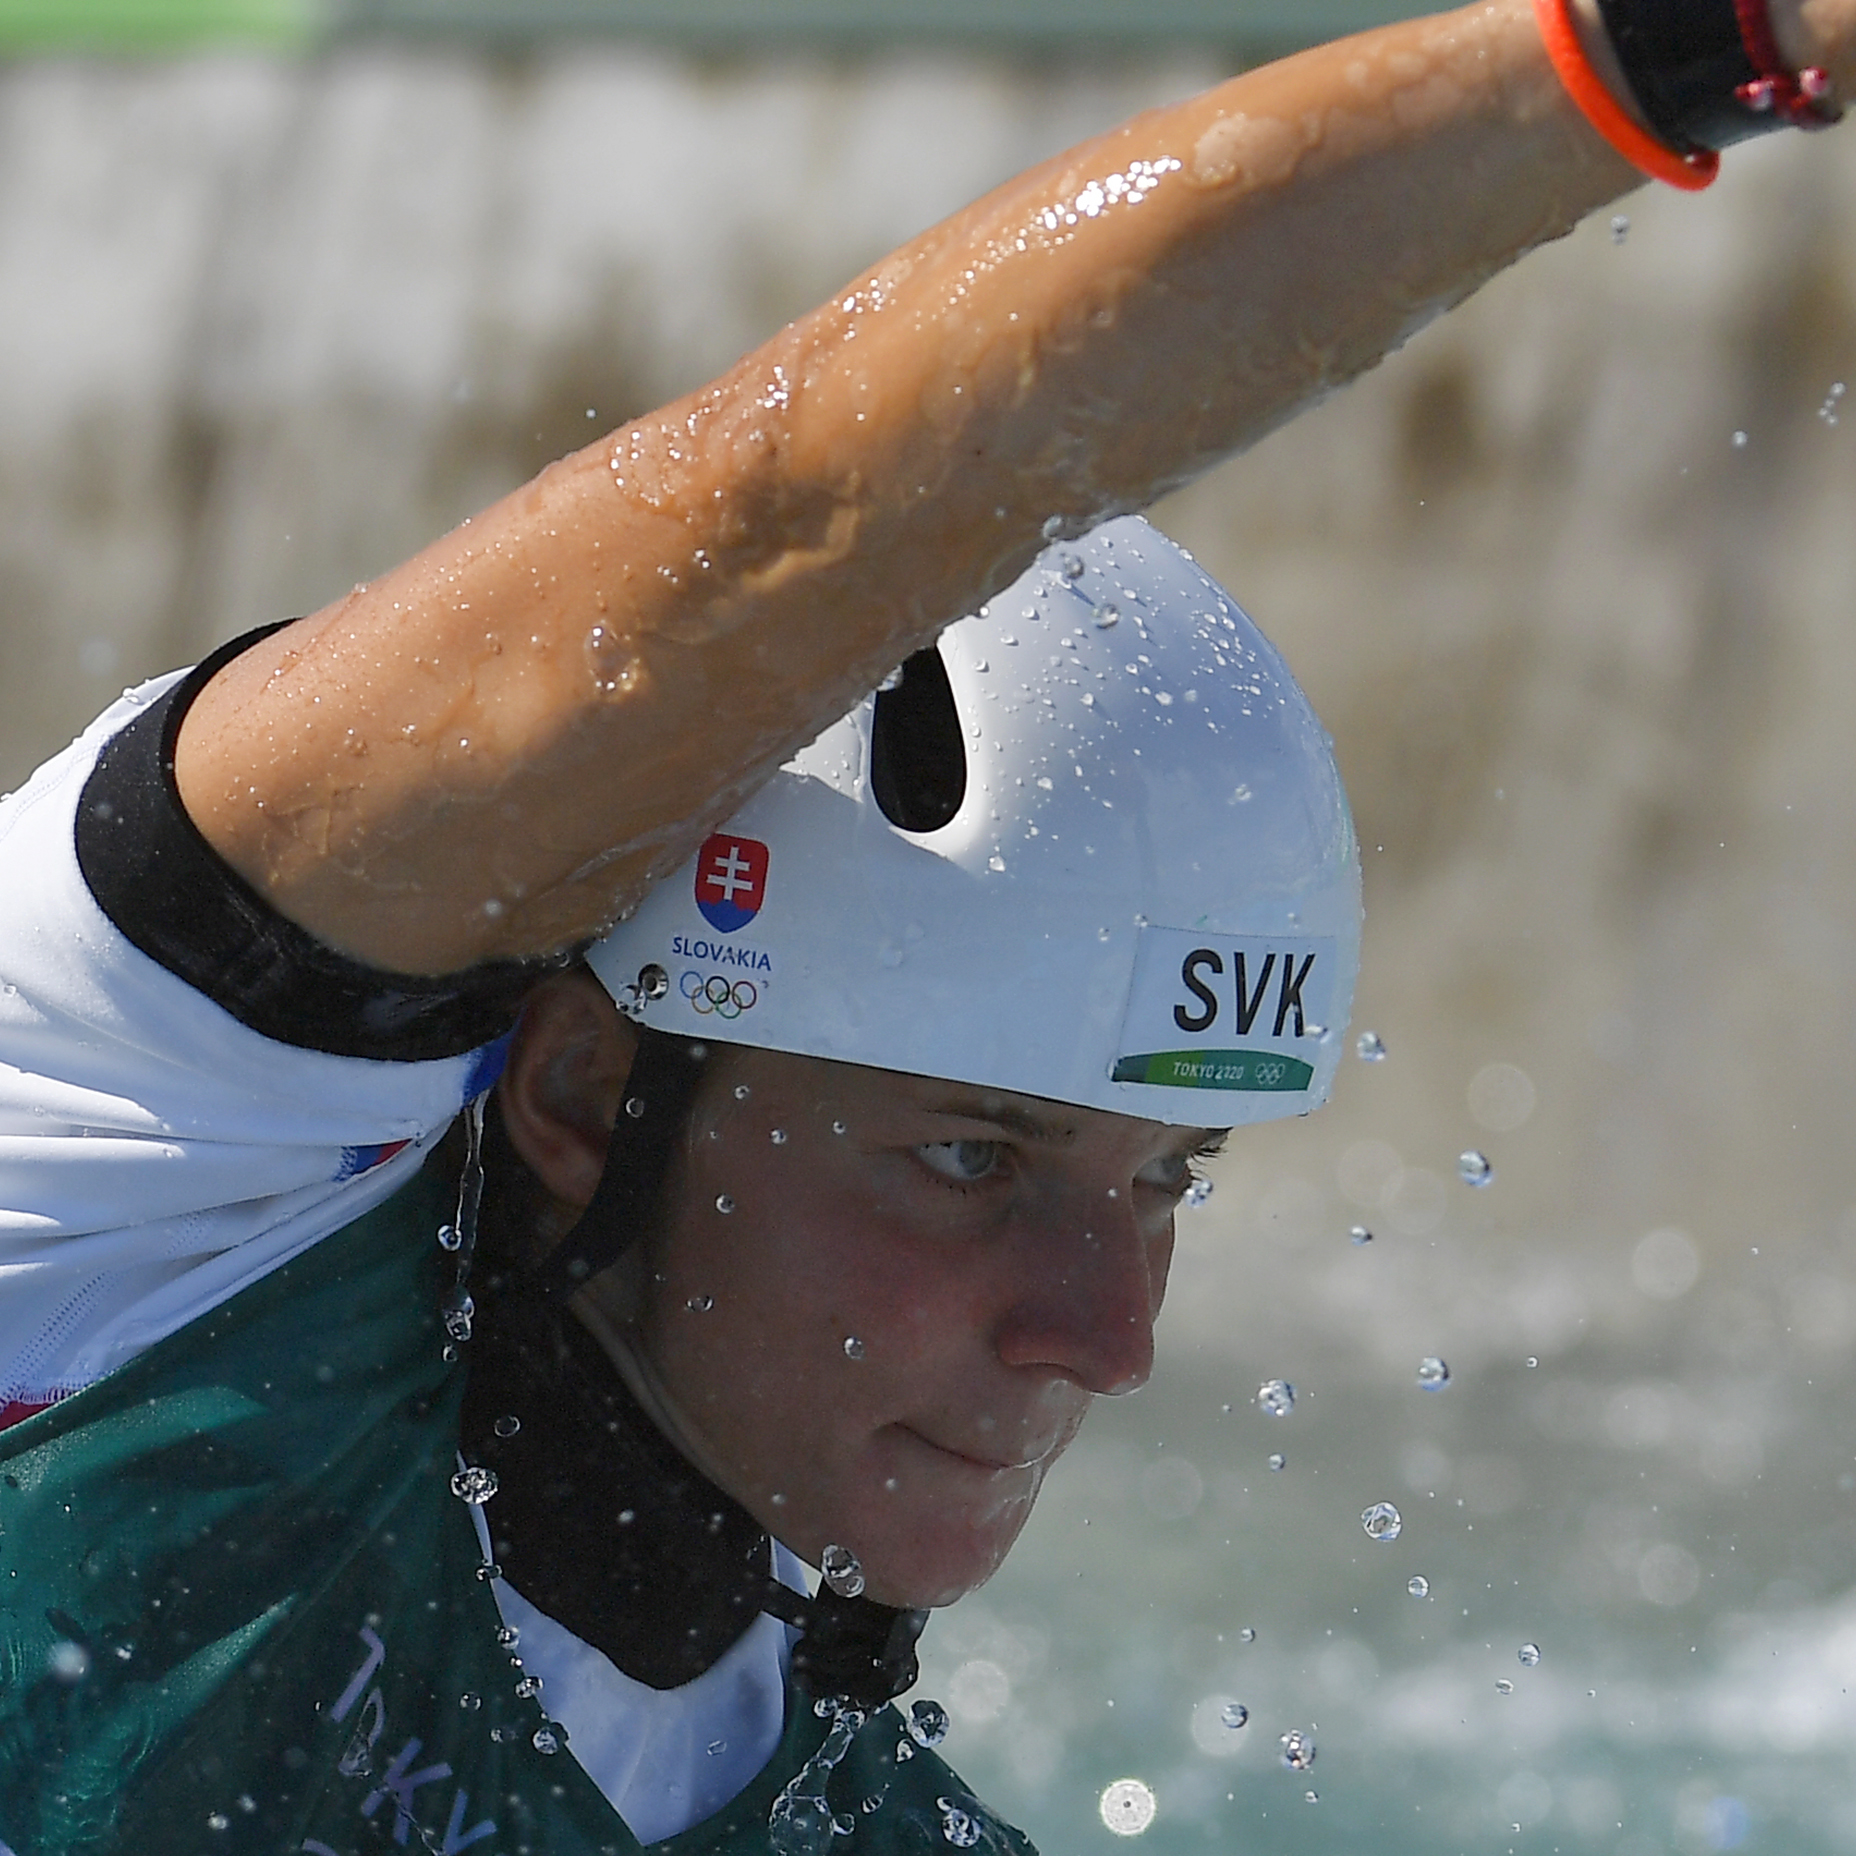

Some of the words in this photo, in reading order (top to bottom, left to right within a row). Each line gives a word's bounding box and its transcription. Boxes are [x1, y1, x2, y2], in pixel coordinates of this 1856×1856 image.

[672, 937, 772, 972] SLOVAKIA
[1173, 948, 1316, 1038] SVK
[1173, 1062, 1214, 1079] TOKYO
